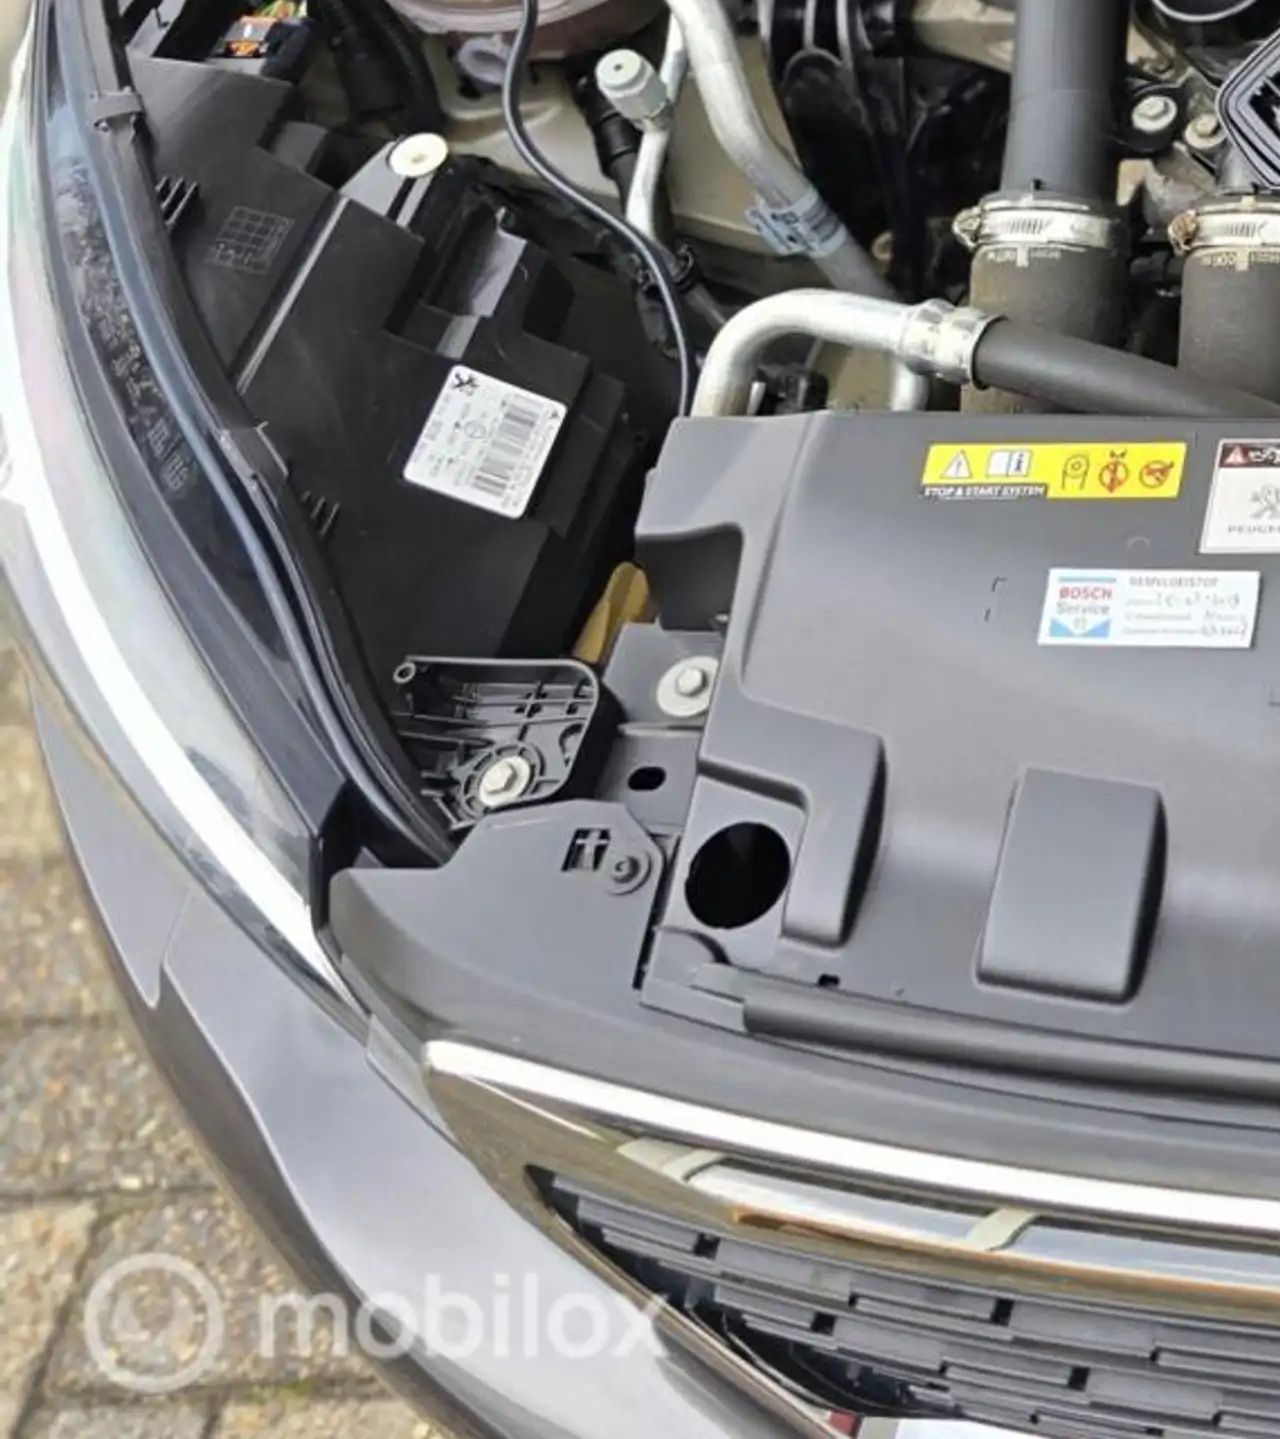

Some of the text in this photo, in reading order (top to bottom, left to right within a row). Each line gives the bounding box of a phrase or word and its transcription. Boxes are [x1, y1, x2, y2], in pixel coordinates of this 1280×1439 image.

[924, 485, 953, 497] STOP
[965, 485, 1000, 497] START
[1001, 485, 1045, 497] SYSTEM
[1058, 585, 1114, 601] BOSCH
[1056, 601, 1111, 616] Service
